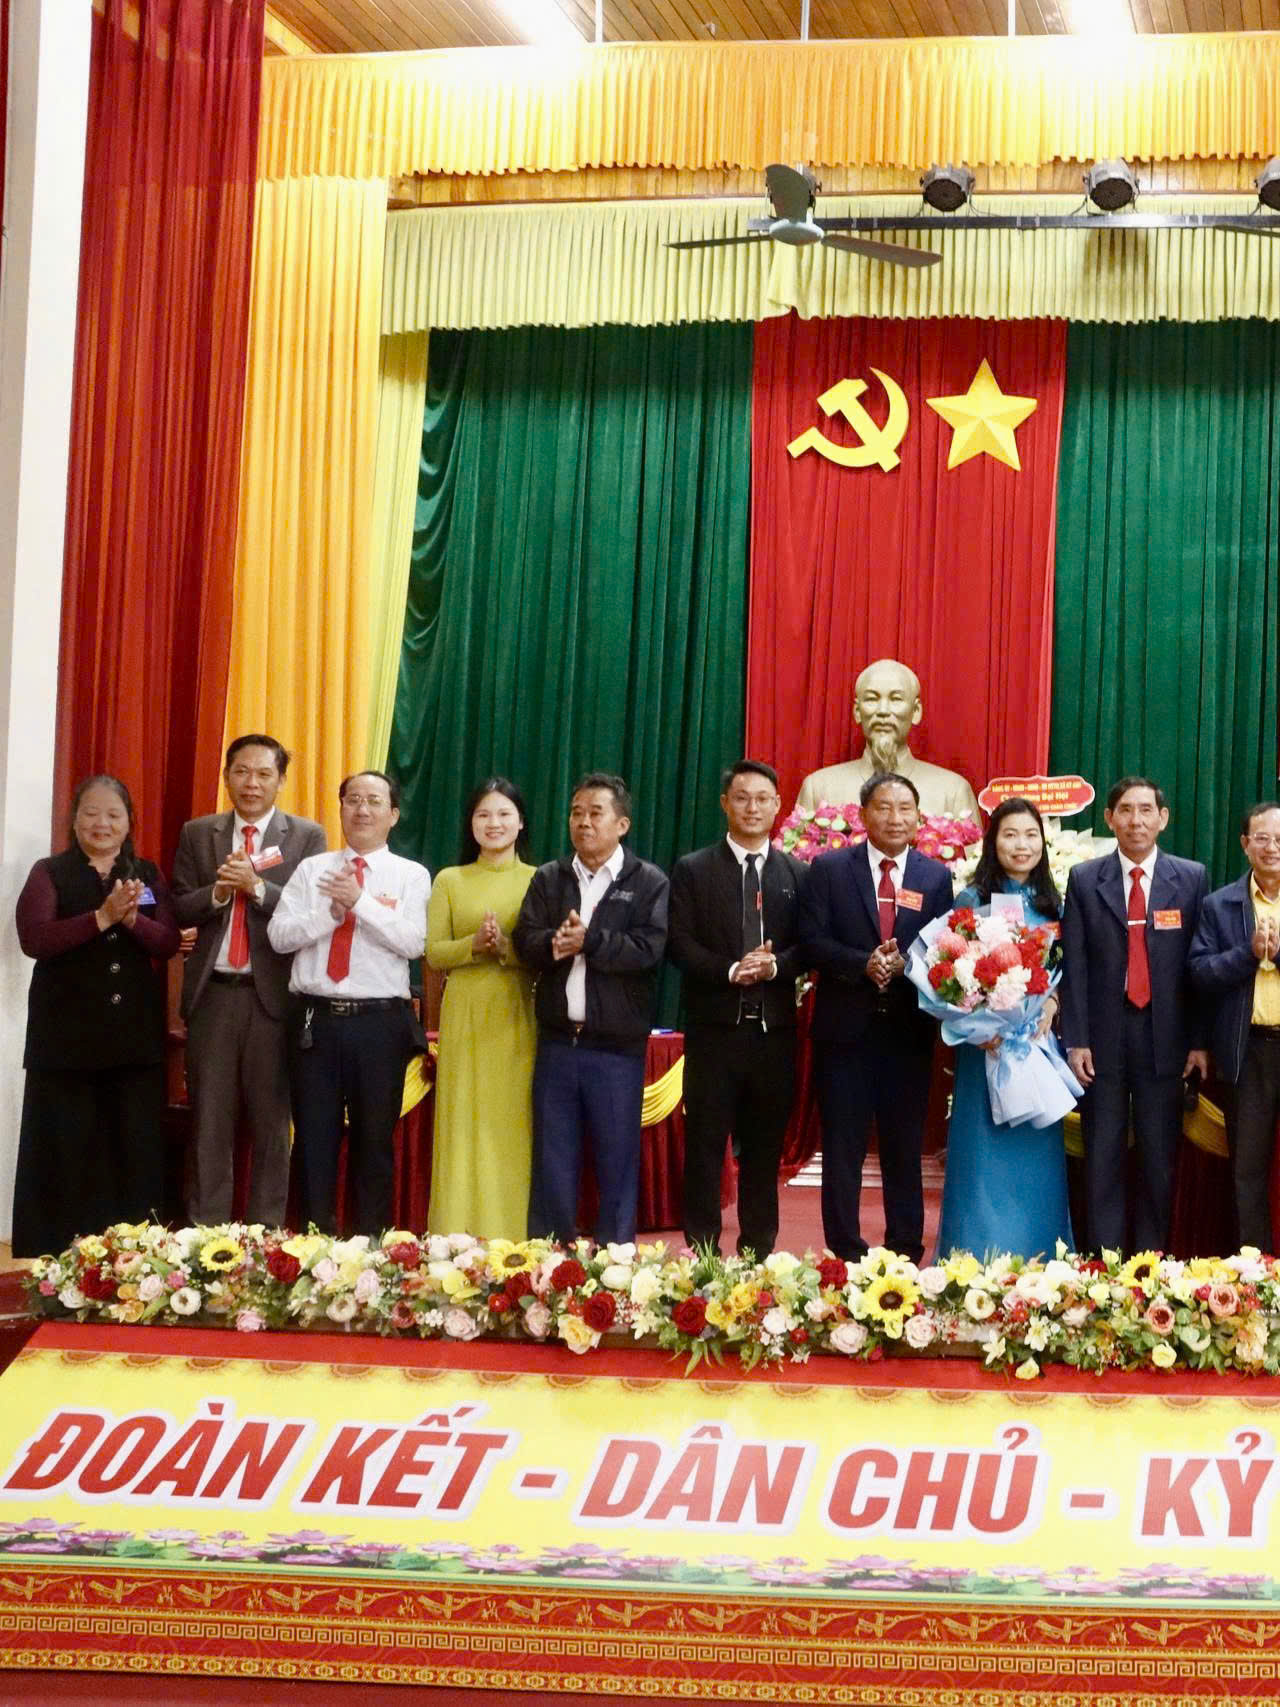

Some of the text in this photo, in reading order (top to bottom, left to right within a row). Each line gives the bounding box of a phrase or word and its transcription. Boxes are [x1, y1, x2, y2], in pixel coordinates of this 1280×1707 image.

[4, 1402, 306, 1501] ĐOÀN
[301, 1406, 508, 1511] KẾT
[519, 1472, 562, 1490] -
[580, 1424, 804, 1526] DÂN
[827, 1426, 1038, 1534] CHỦ
[1070, 1493, 1105, 1509] -
[1141, 1430, 1274, 1538] KỶ
